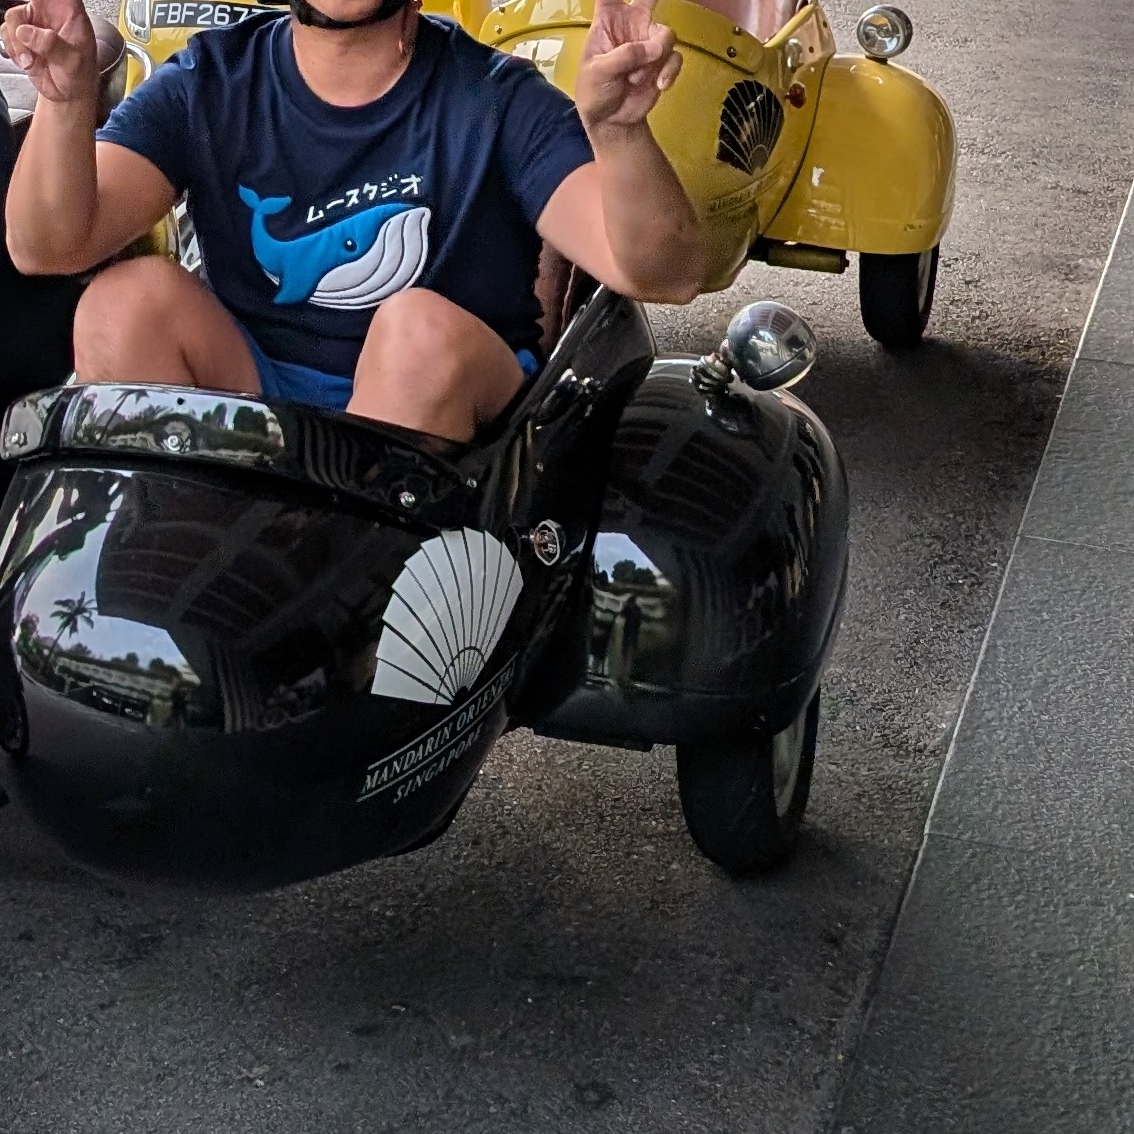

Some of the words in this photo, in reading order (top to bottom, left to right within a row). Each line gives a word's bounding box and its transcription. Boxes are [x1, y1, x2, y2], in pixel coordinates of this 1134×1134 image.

[153, 2, 264, 26] FBF267
[306, 173, 425, 224] ムースタジオ
[361, 721, 455, 795] MANDARIN
[393, 722, 484, 803] SINGAPORE
